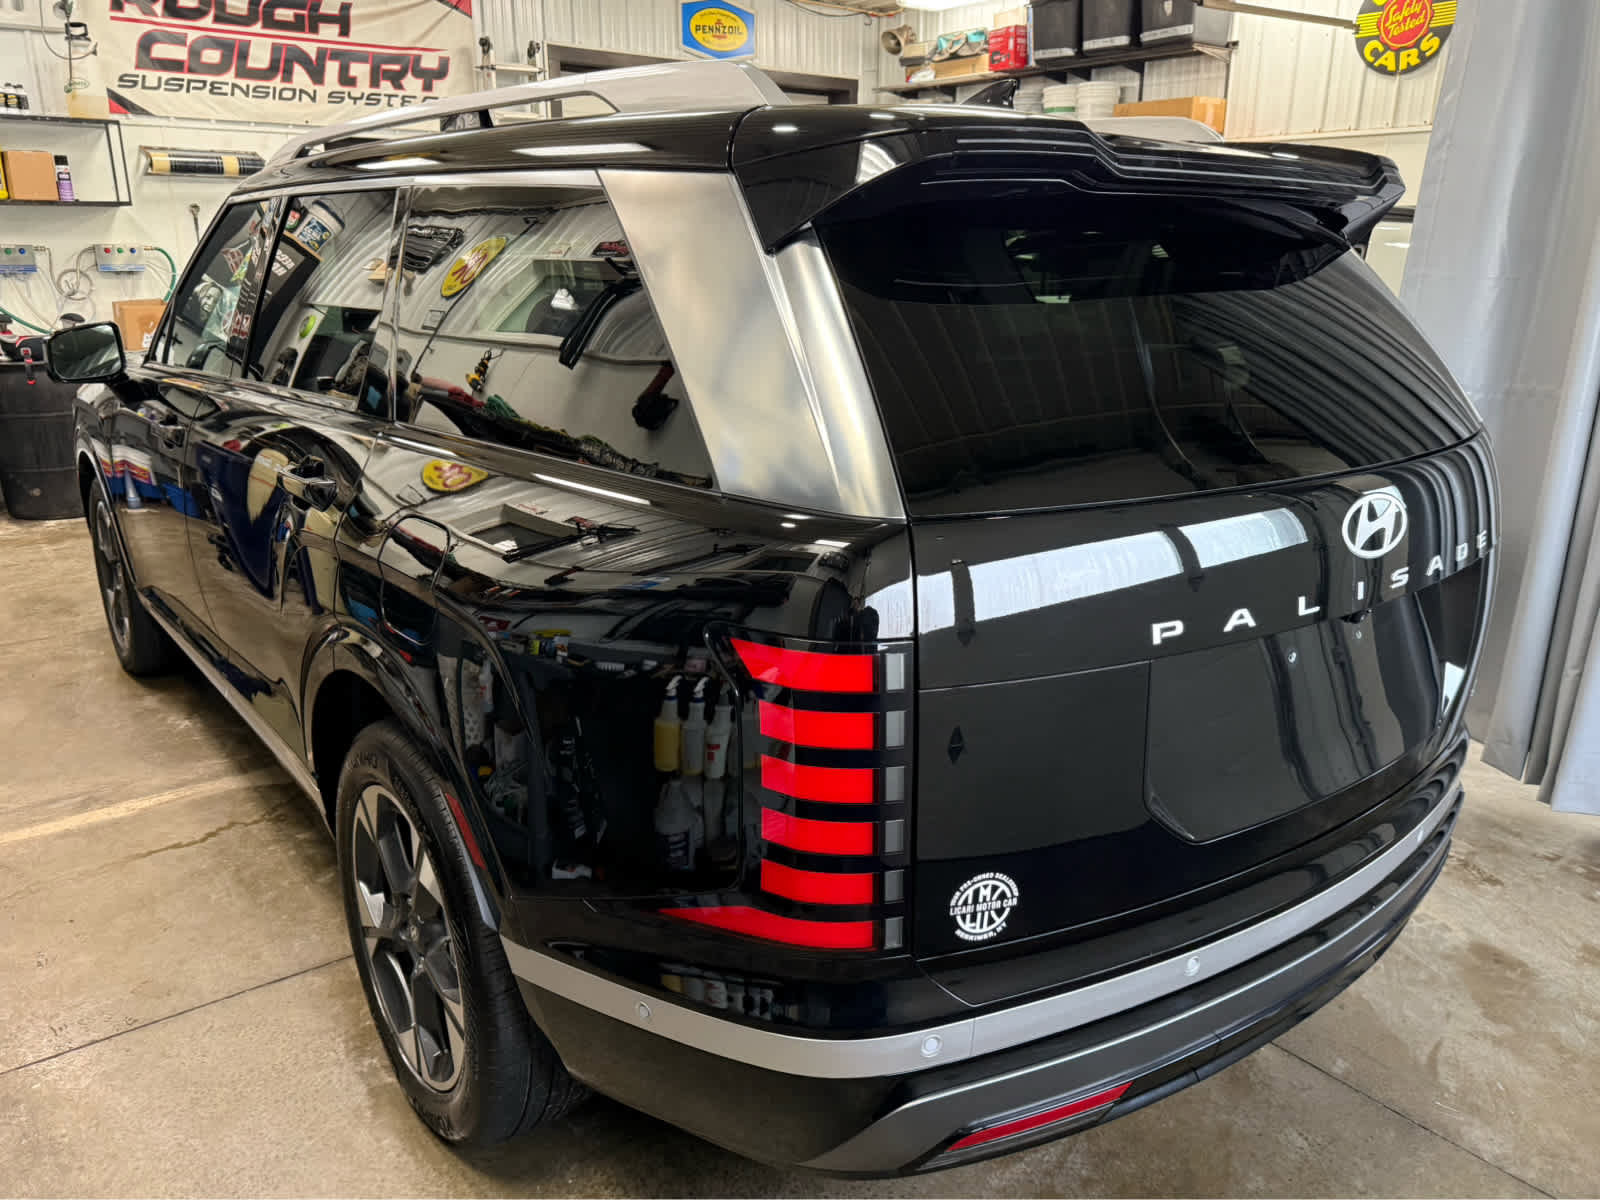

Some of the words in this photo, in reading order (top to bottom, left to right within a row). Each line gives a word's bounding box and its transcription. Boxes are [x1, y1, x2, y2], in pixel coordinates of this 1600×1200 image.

[695, 24, 744, 35] PENNZOIL
[1388, 9, 1426, 39] Tested
[135, 29, 450, 92] COUNTRY
[1363, 32, 1440, 72] CARS
[117, 73, 317, 104] SUSPENSION
[1152, 530, 1488, 646] PALISADE
[950, 903, 975, 916] LICARI
[976, 900, 1001, 912] MOTOR
[1002, 897, 1018, 908] CAR
